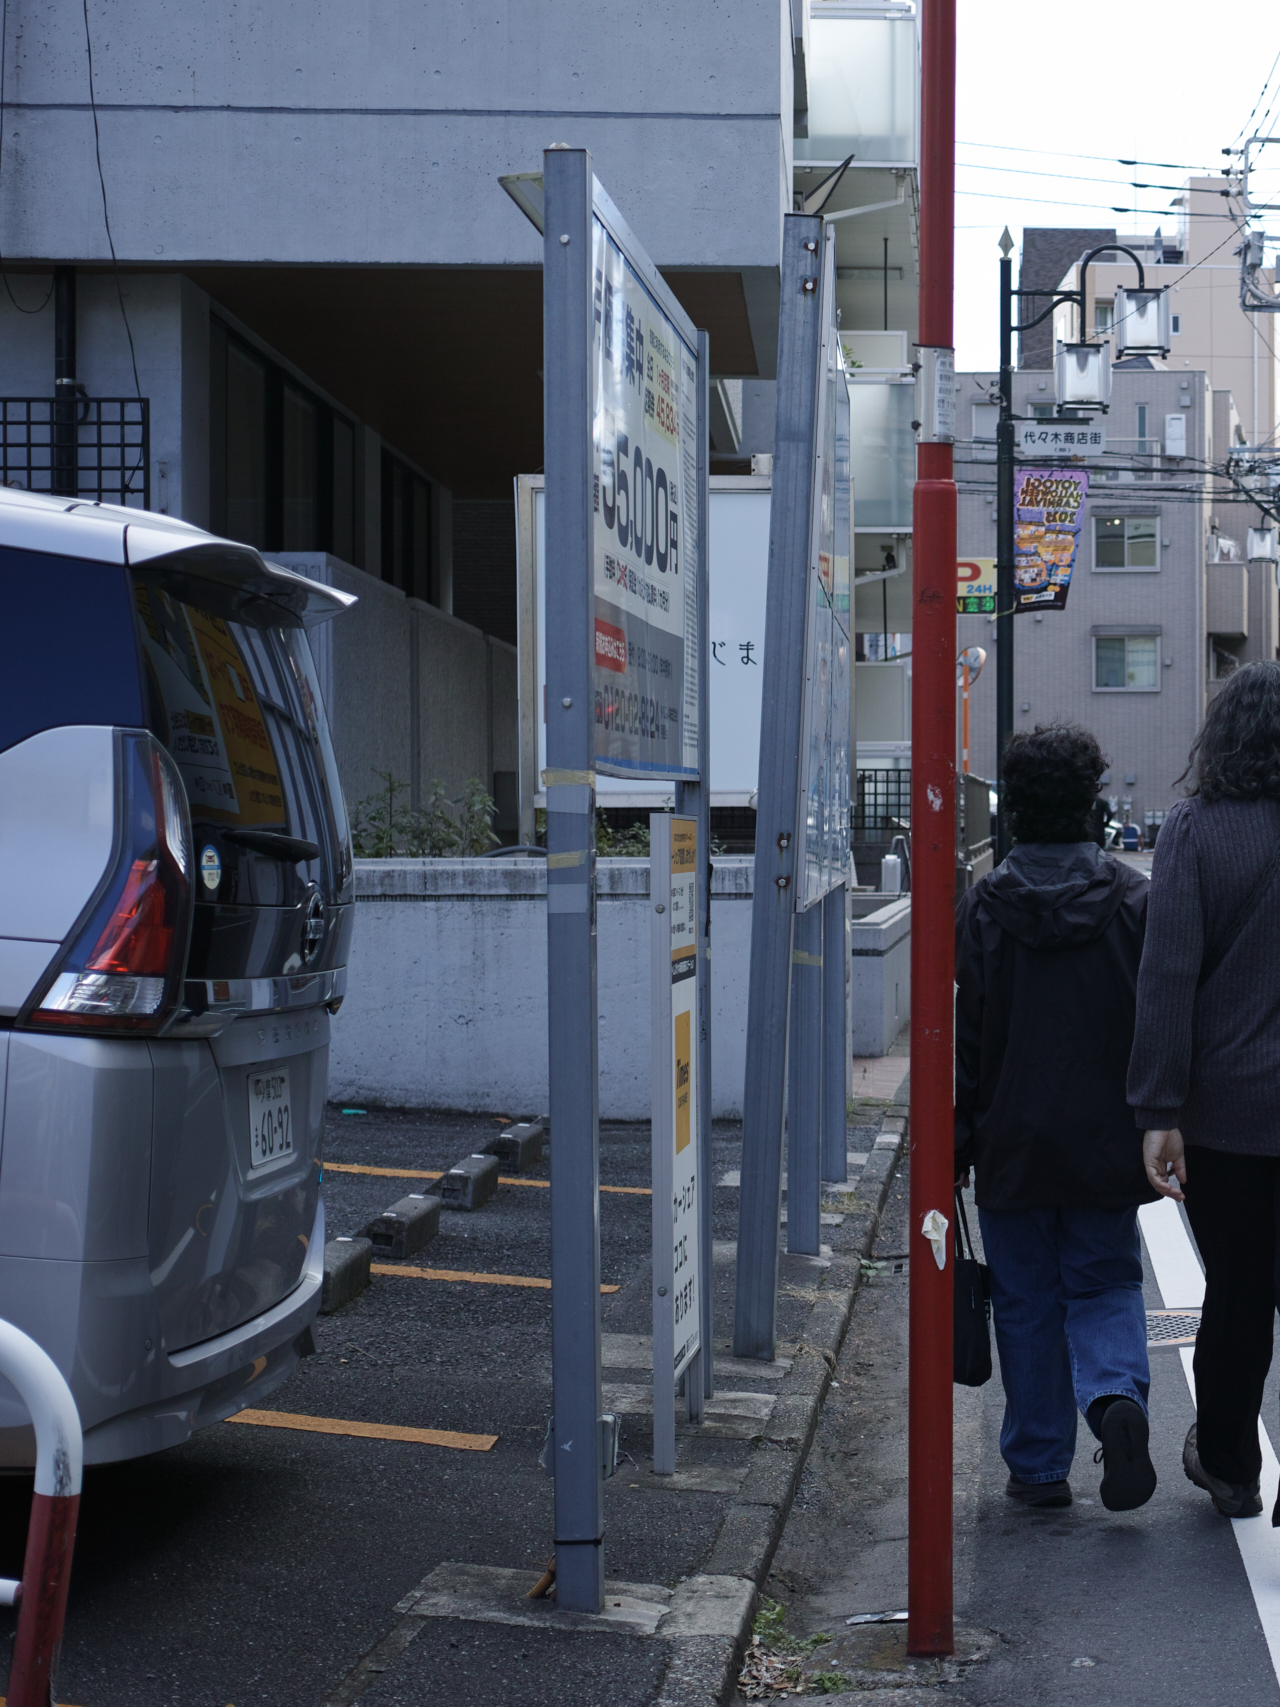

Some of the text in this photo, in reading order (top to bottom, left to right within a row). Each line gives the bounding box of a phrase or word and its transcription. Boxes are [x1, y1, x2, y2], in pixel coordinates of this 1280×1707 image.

[1023, 430, 1103, 445] 代々木商店街
[965, 596, 995, 613] 空車
[966, 584, 992, 594] 24H
[676, 1058, 689, 1089] Times
[261, 1104, 291, 1158] 60-92
[673, 1174, 695, 1224] カーシェア
[674, 1234, 688, 1274] ココに
